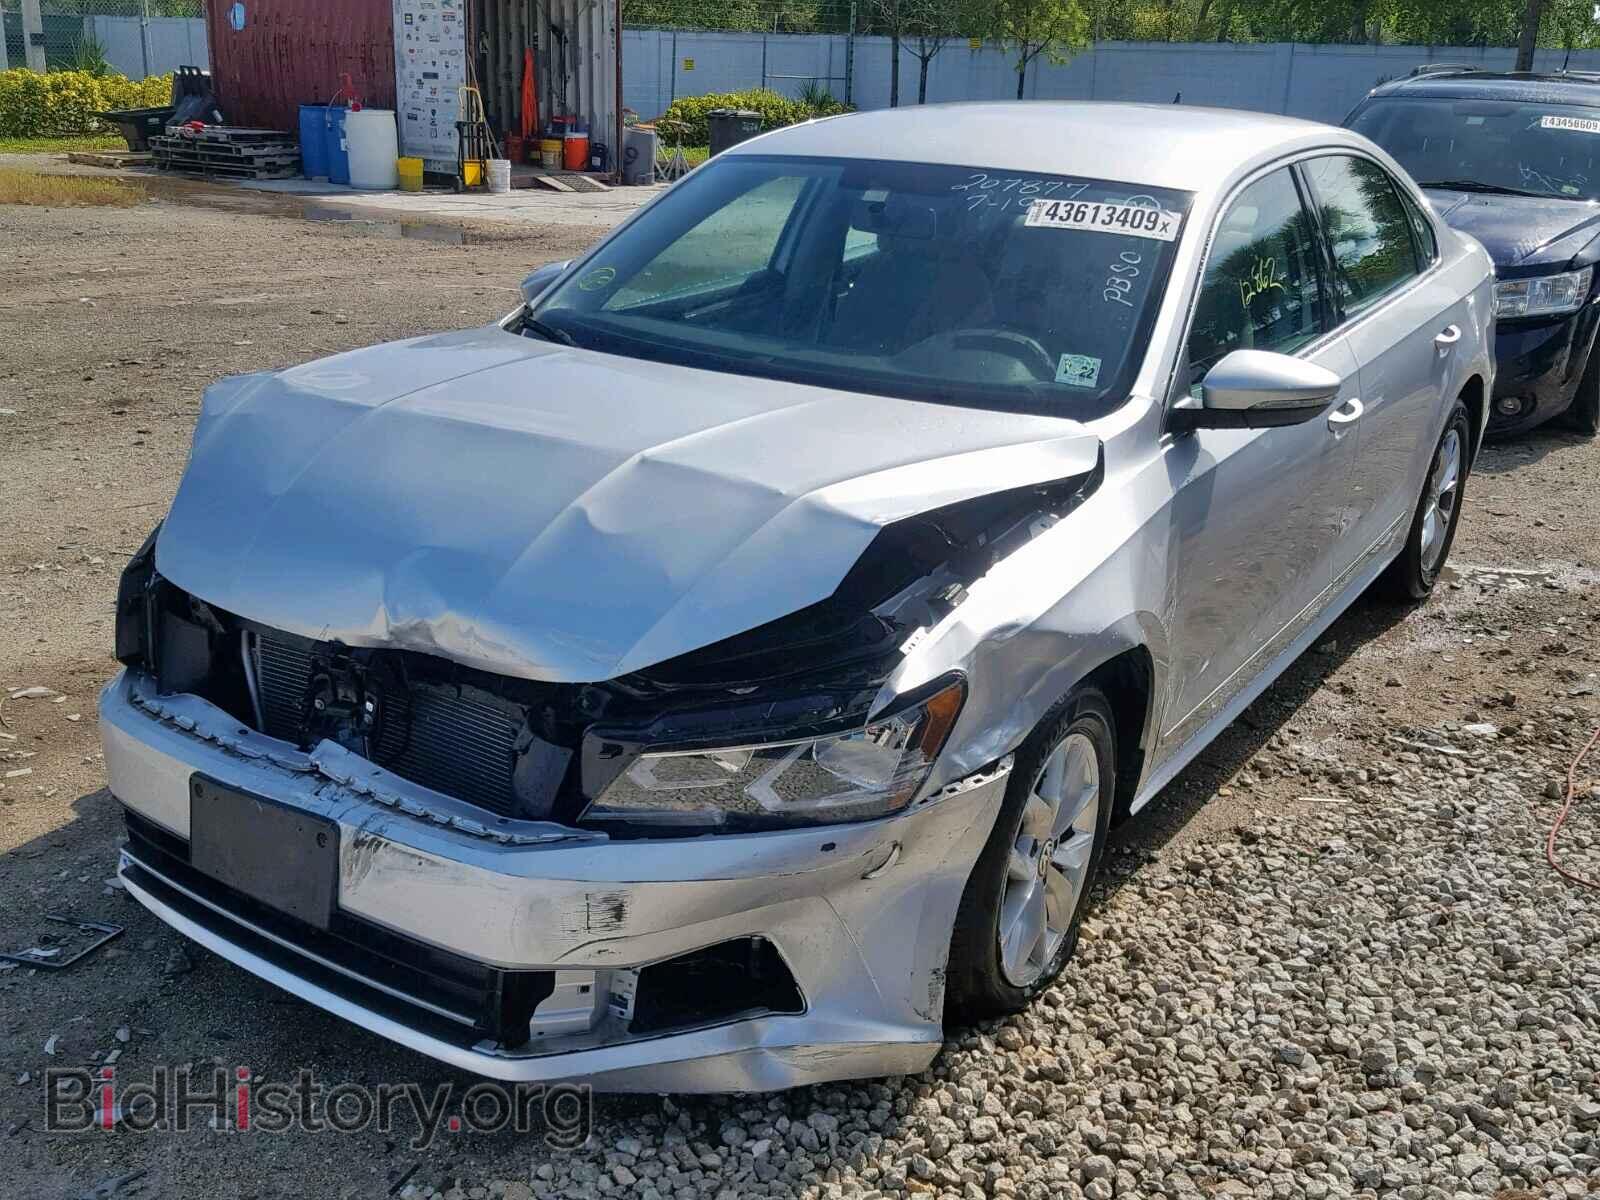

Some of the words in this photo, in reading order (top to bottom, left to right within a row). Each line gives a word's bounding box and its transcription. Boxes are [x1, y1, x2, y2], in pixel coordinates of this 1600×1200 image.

[952, 174, 1090, 199] 207877
[1045, 202, 1160, 231] 43613409
[1103, 251, 1142, 307] PBSO
